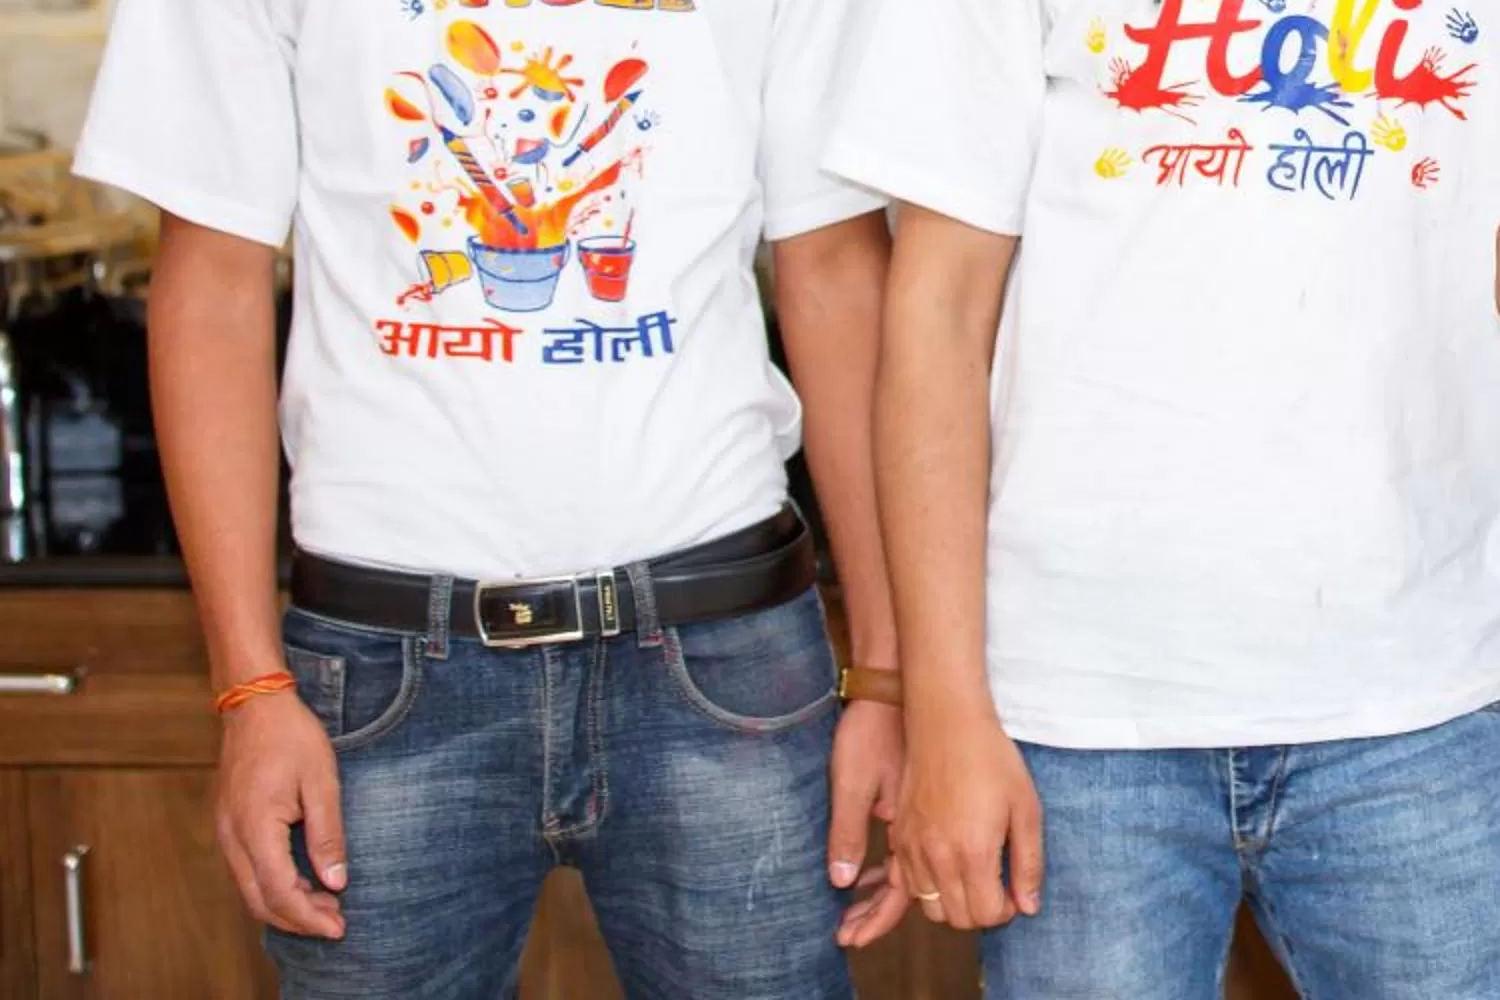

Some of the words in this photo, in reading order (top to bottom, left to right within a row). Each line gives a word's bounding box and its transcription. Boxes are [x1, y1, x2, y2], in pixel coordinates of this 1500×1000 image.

[1266, 127, 1375, 200] होली
[374, 316, 524, 363] आयो
[541, 309, 678, 365] होली
